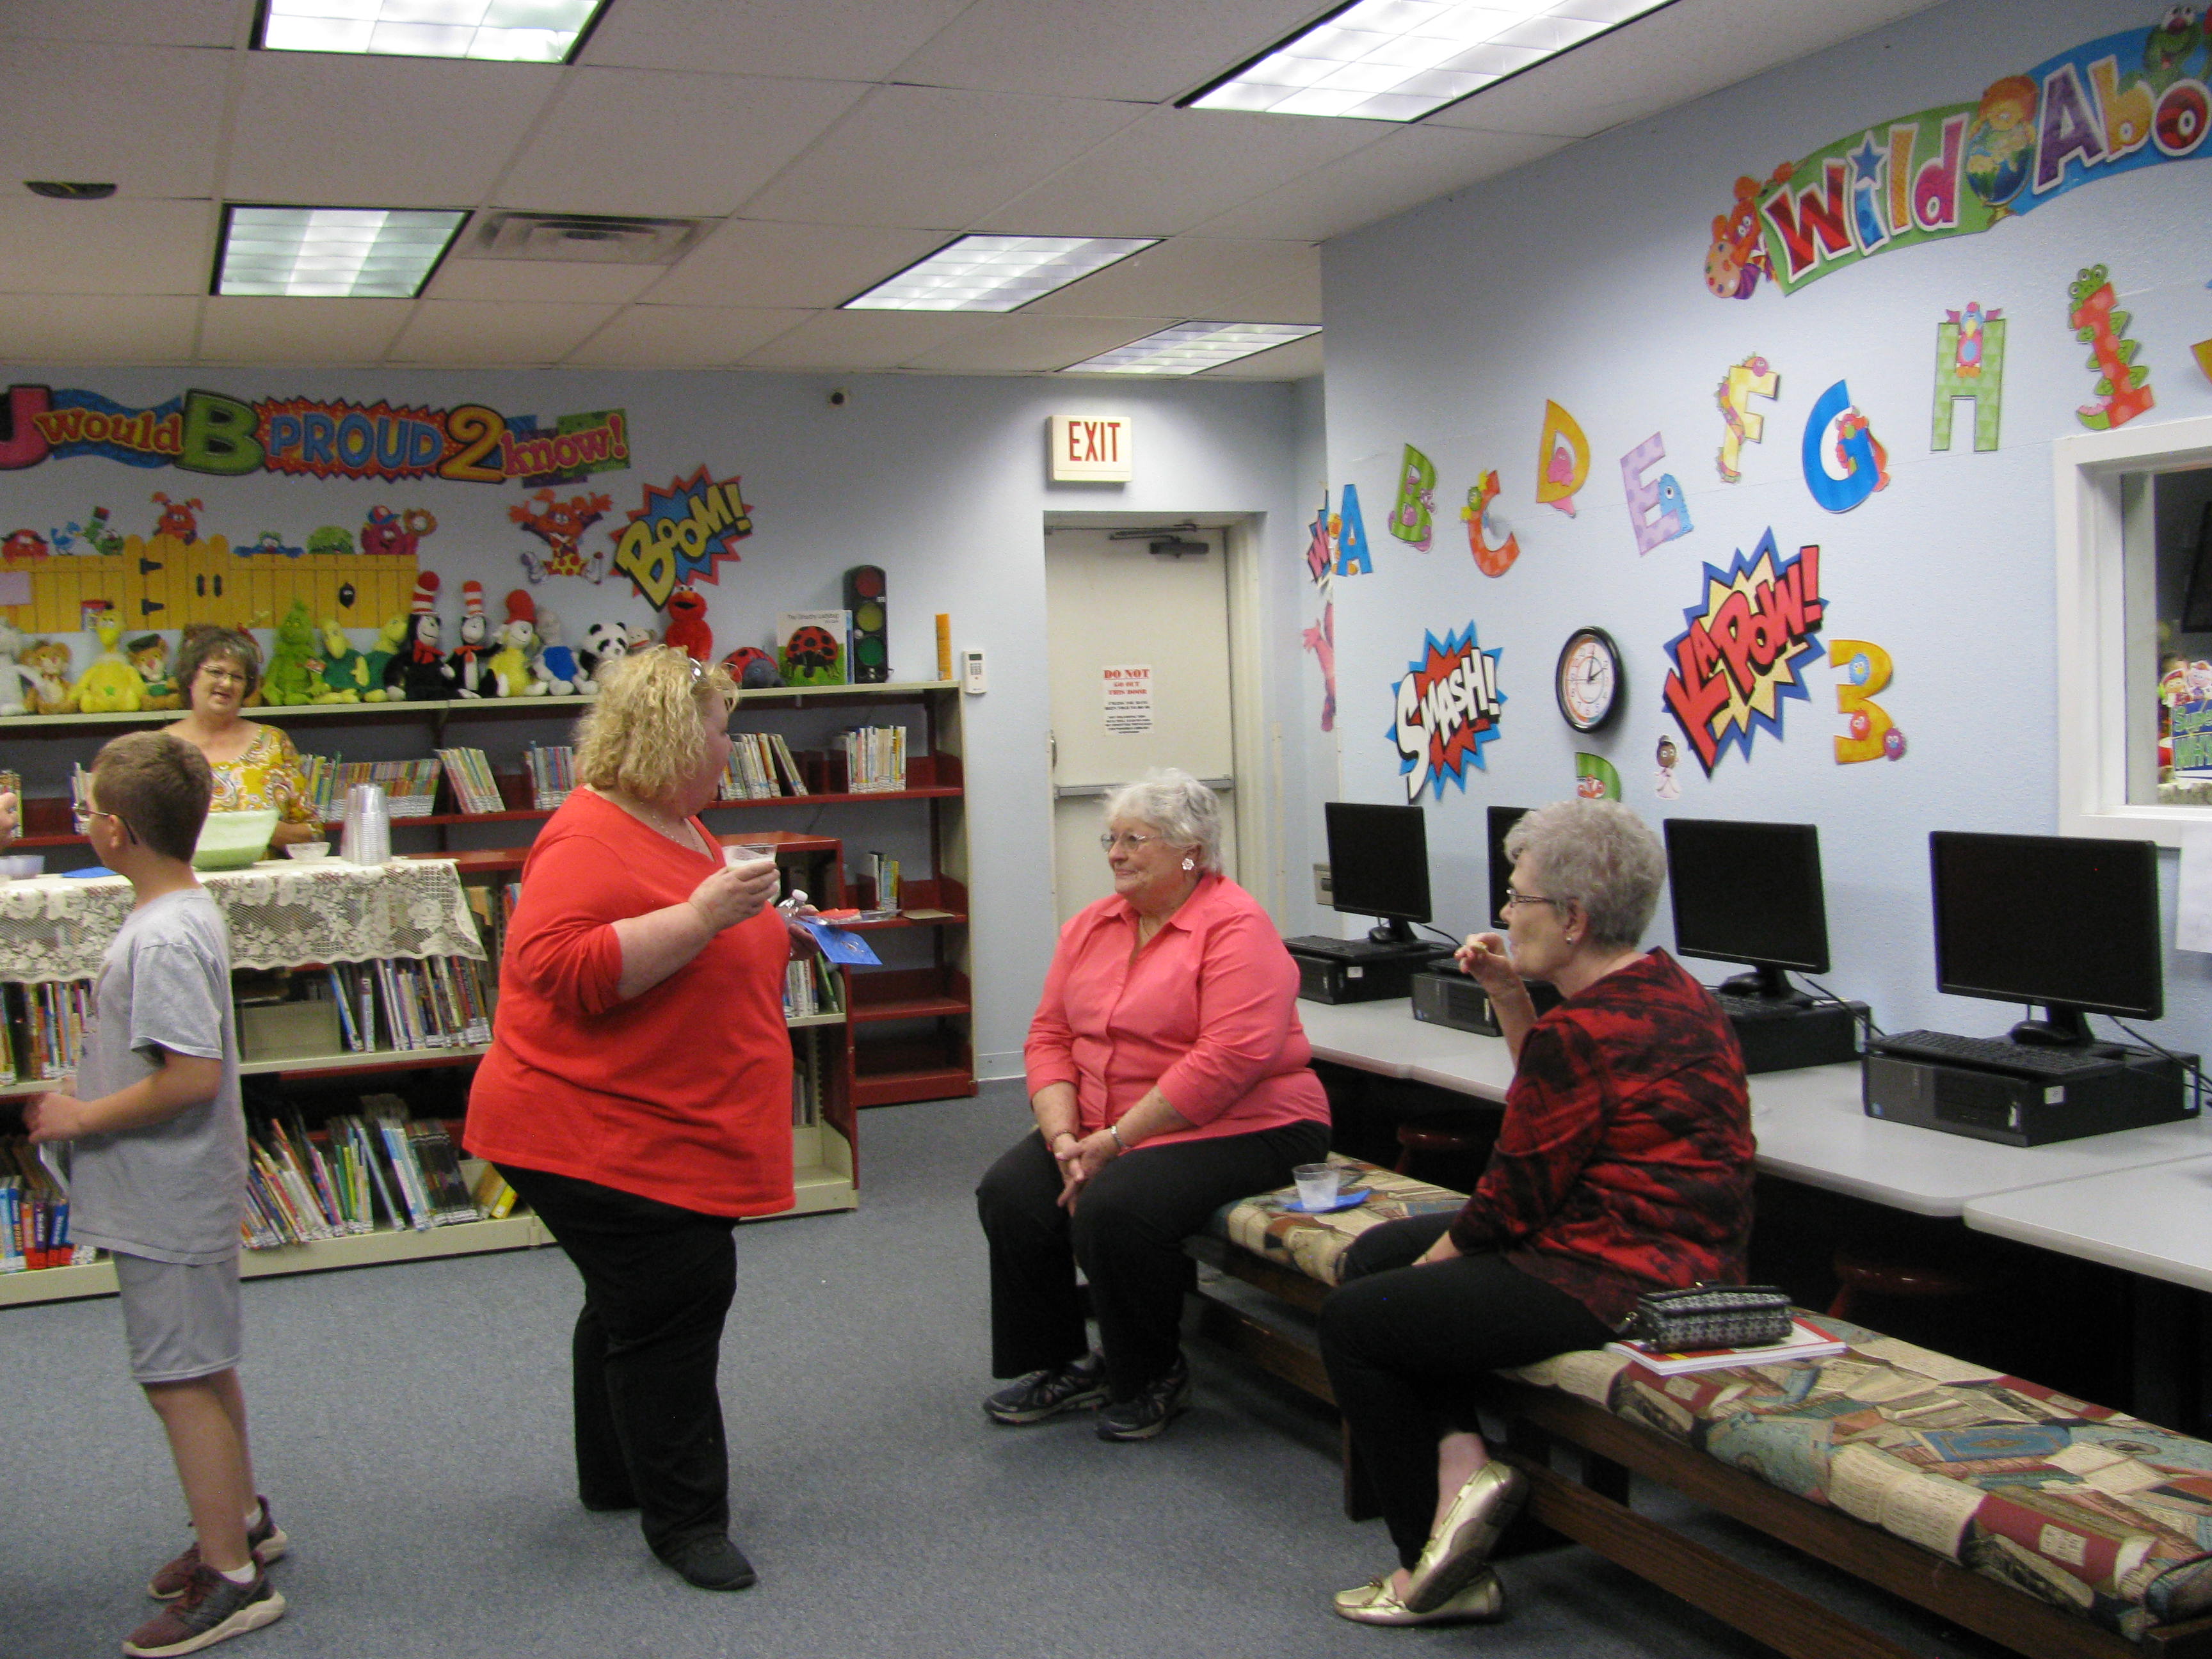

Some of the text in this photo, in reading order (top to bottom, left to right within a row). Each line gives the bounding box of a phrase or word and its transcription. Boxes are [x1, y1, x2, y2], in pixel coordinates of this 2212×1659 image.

[1761, 113, 1970, 283] Wild
[33, 407, 184, 455] would
[175, 388, 265, 476] B
[269, 412, 444, 469] PROUD
[438, 404, 508, 484] 2
[499, 413, 629, 478] know!
[1068, 421, 1121, 462] EXIT
[1336, 484, 1373, 576] A
[1390, 444, 1438, 543] B
[1466, 470, 1521, 578] C
[1536, 399, 1591, 503] D
[1619, 431, 1681, 556] E
[1718, 364, 1779, 481] F
[1802, 379, 1880, 512] G
[1930, 319, 2007, 452] H
[2072, 282, 2155, 429] I
[614, 482, 753, 612] BOOM!
[1103, 669, 1151, 678] DO NOT
[1395, 646, 1502, 805] SMASH!
[1829, 639, 1896, 765] 3
